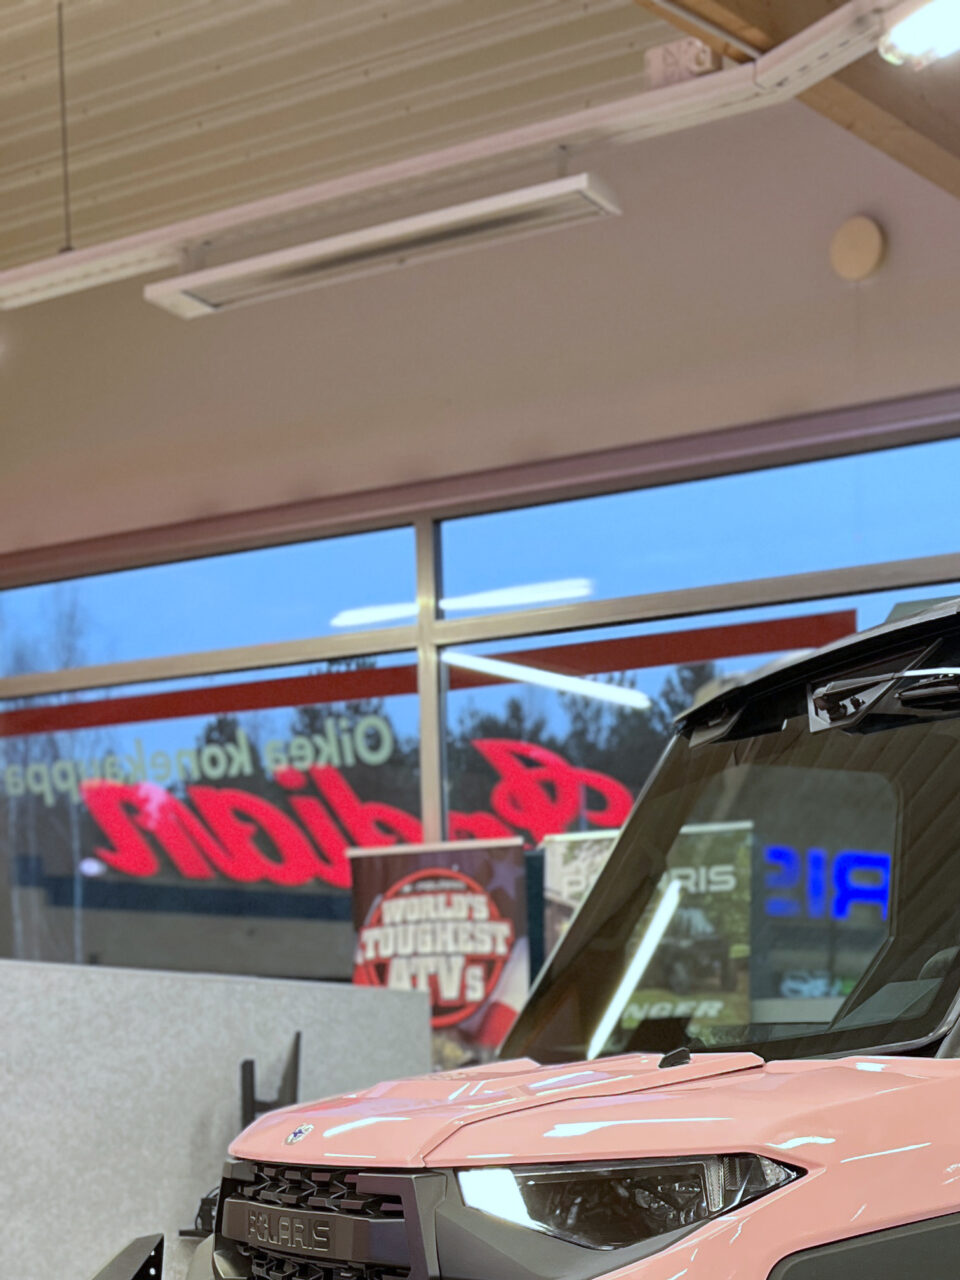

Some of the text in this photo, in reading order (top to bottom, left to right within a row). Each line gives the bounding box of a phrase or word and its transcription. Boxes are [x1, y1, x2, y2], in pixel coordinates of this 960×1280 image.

[382, 893, 489, 924] WORLD'S
[361, 922, 511, 960] TOUGHEST
[388, 956, 485, 1001] ATVs
[248, 1209, 331, 1251] POLARIS
